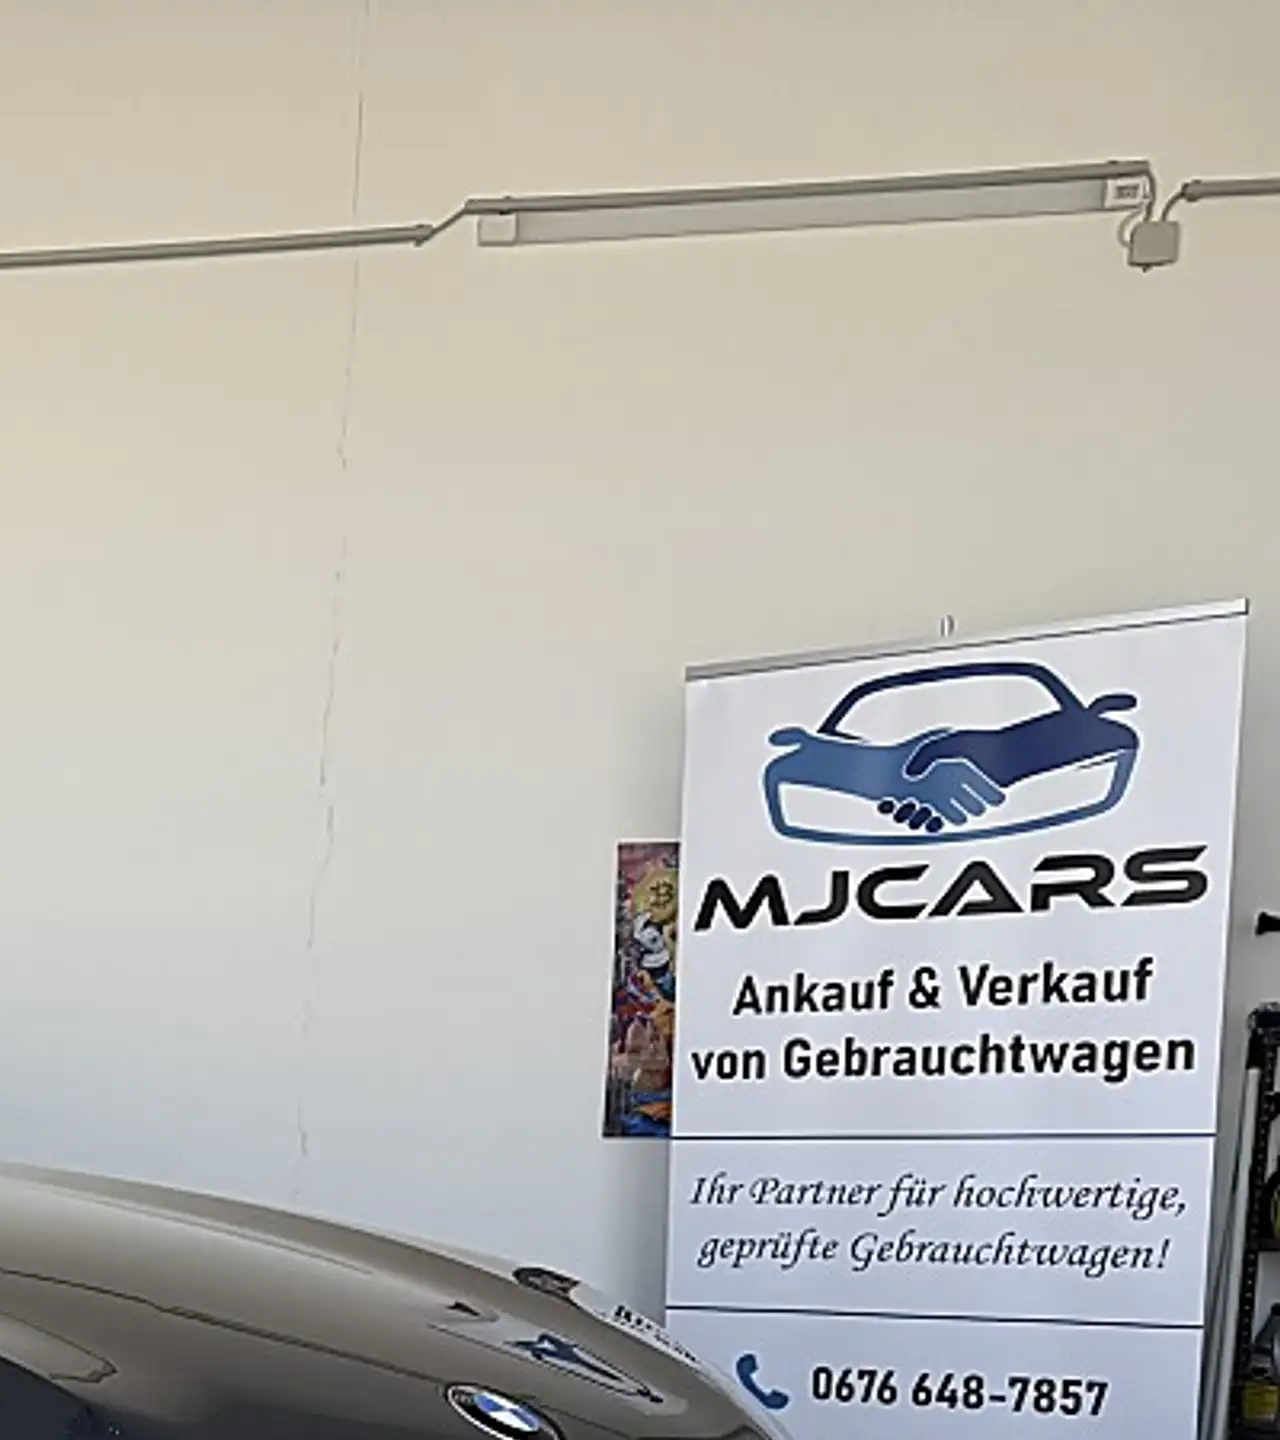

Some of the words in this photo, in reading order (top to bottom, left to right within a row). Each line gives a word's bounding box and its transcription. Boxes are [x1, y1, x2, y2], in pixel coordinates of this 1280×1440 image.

[693, 844, 1208, 931] MJCARS
[732, 969, 896, 1016] Ankauf
[908, 966, 940, 1010] &
[959, 957, 1154, 1006] Verkauf
[690, 1042, 765, 1080] von
[783, 1033, 1196, 1082] Gebrauchtwagen
[690, 1174, 743, 1206] Ihr
[749, 1175, 880, 1207] Partner
[877, 1175, 945, 1218] für
[951, 1177, 1187, 1220] hochwertige,
[696, 1228, 839, 1268] geprüfte
[849, 1232, 1170, 1275] Gebrauchtwagen!
[812, 1367, 898, 1404] 0676
[911, 1373, 1109, 1416] 648-7857
